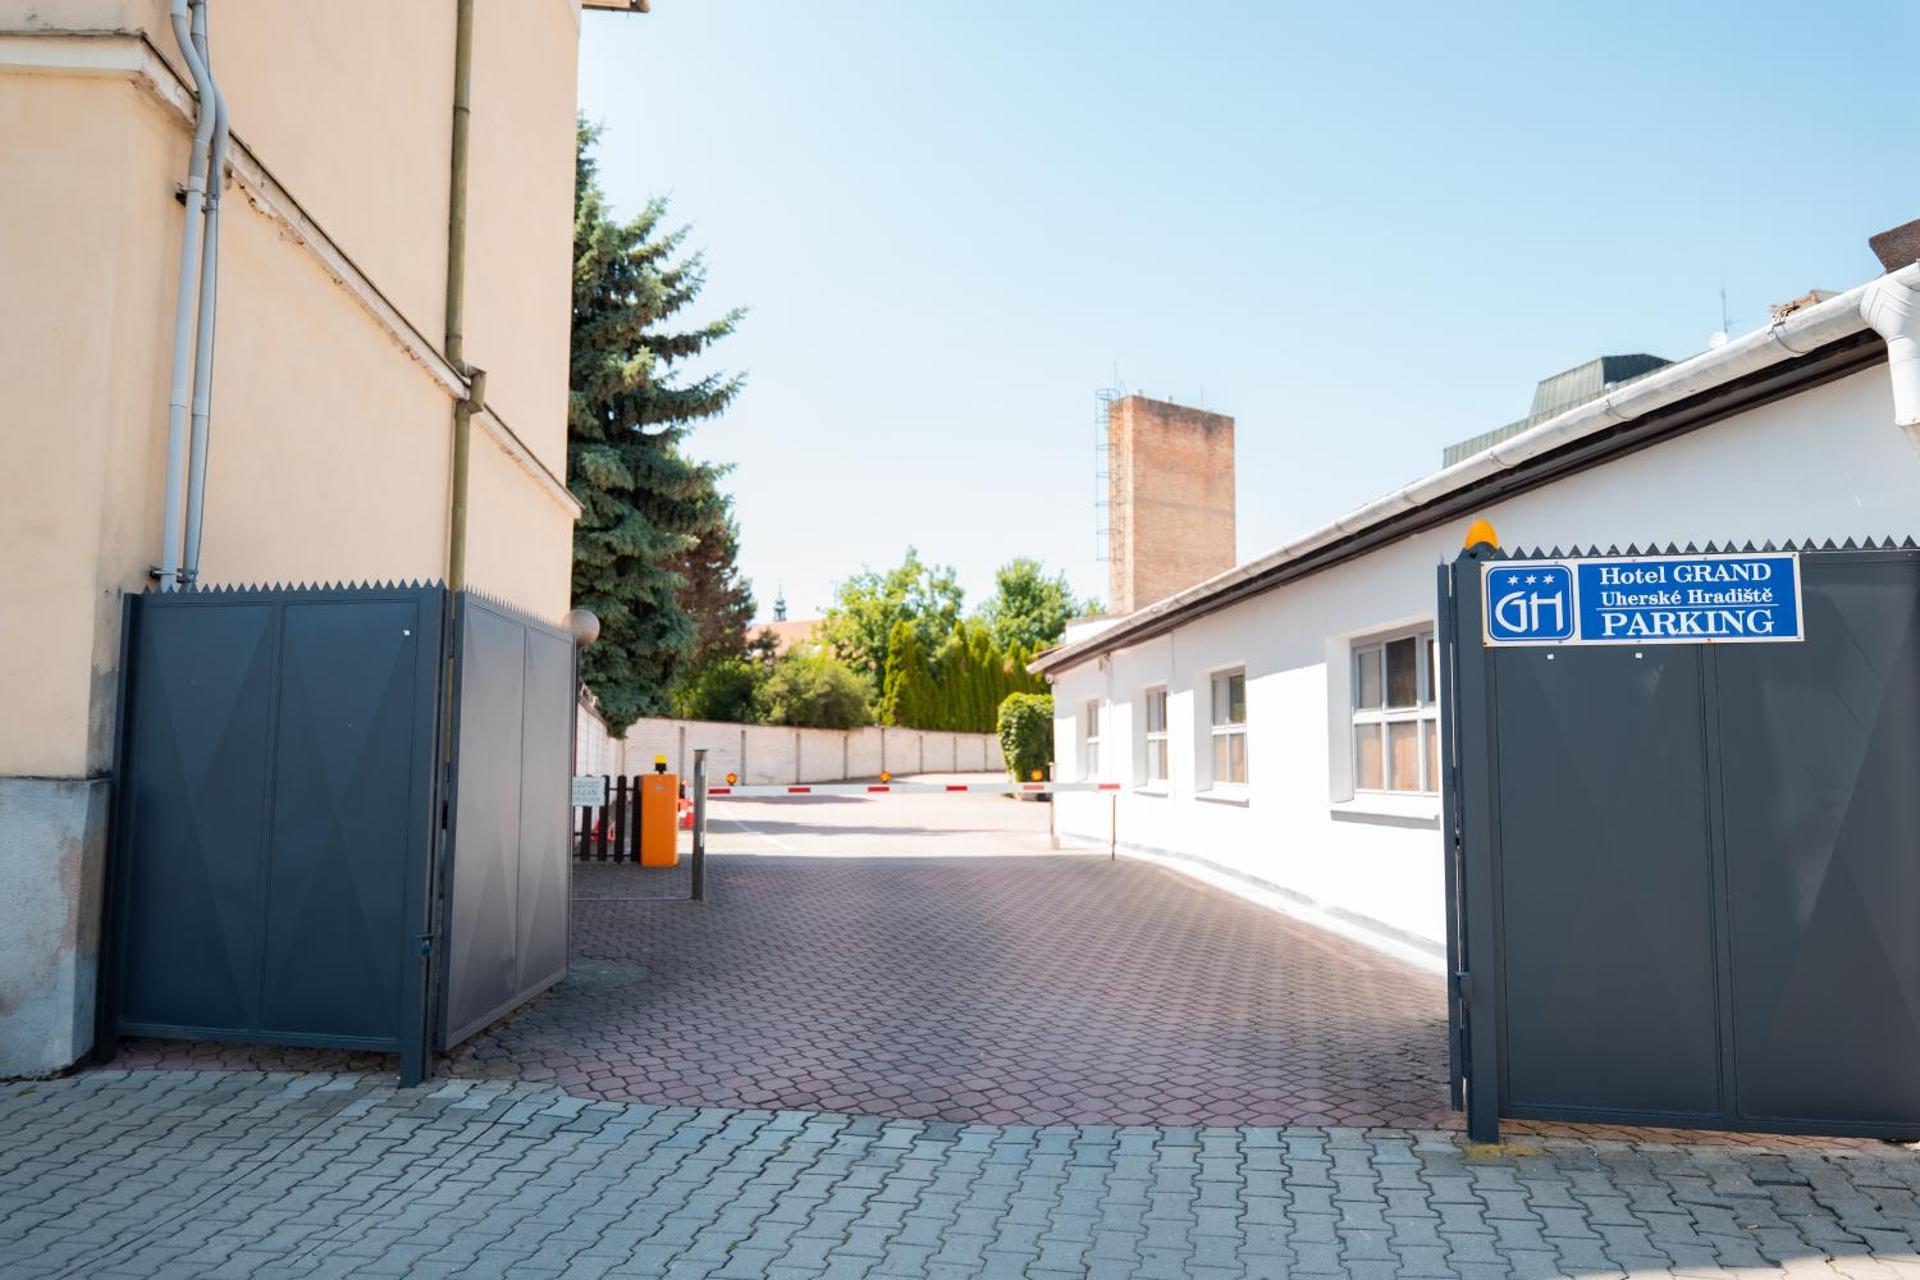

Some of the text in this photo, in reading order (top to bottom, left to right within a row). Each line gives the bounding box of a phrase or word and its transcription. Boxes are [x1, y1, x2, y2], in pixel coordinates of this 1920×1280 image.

[1600, 563, 1771, 585] Hotel GRAND
[1601, 587, 1773, 606] Uherské Hradiště
[1495, 590, 1563, 633] GH
[1601, 609, 1775, 636] PARKING
